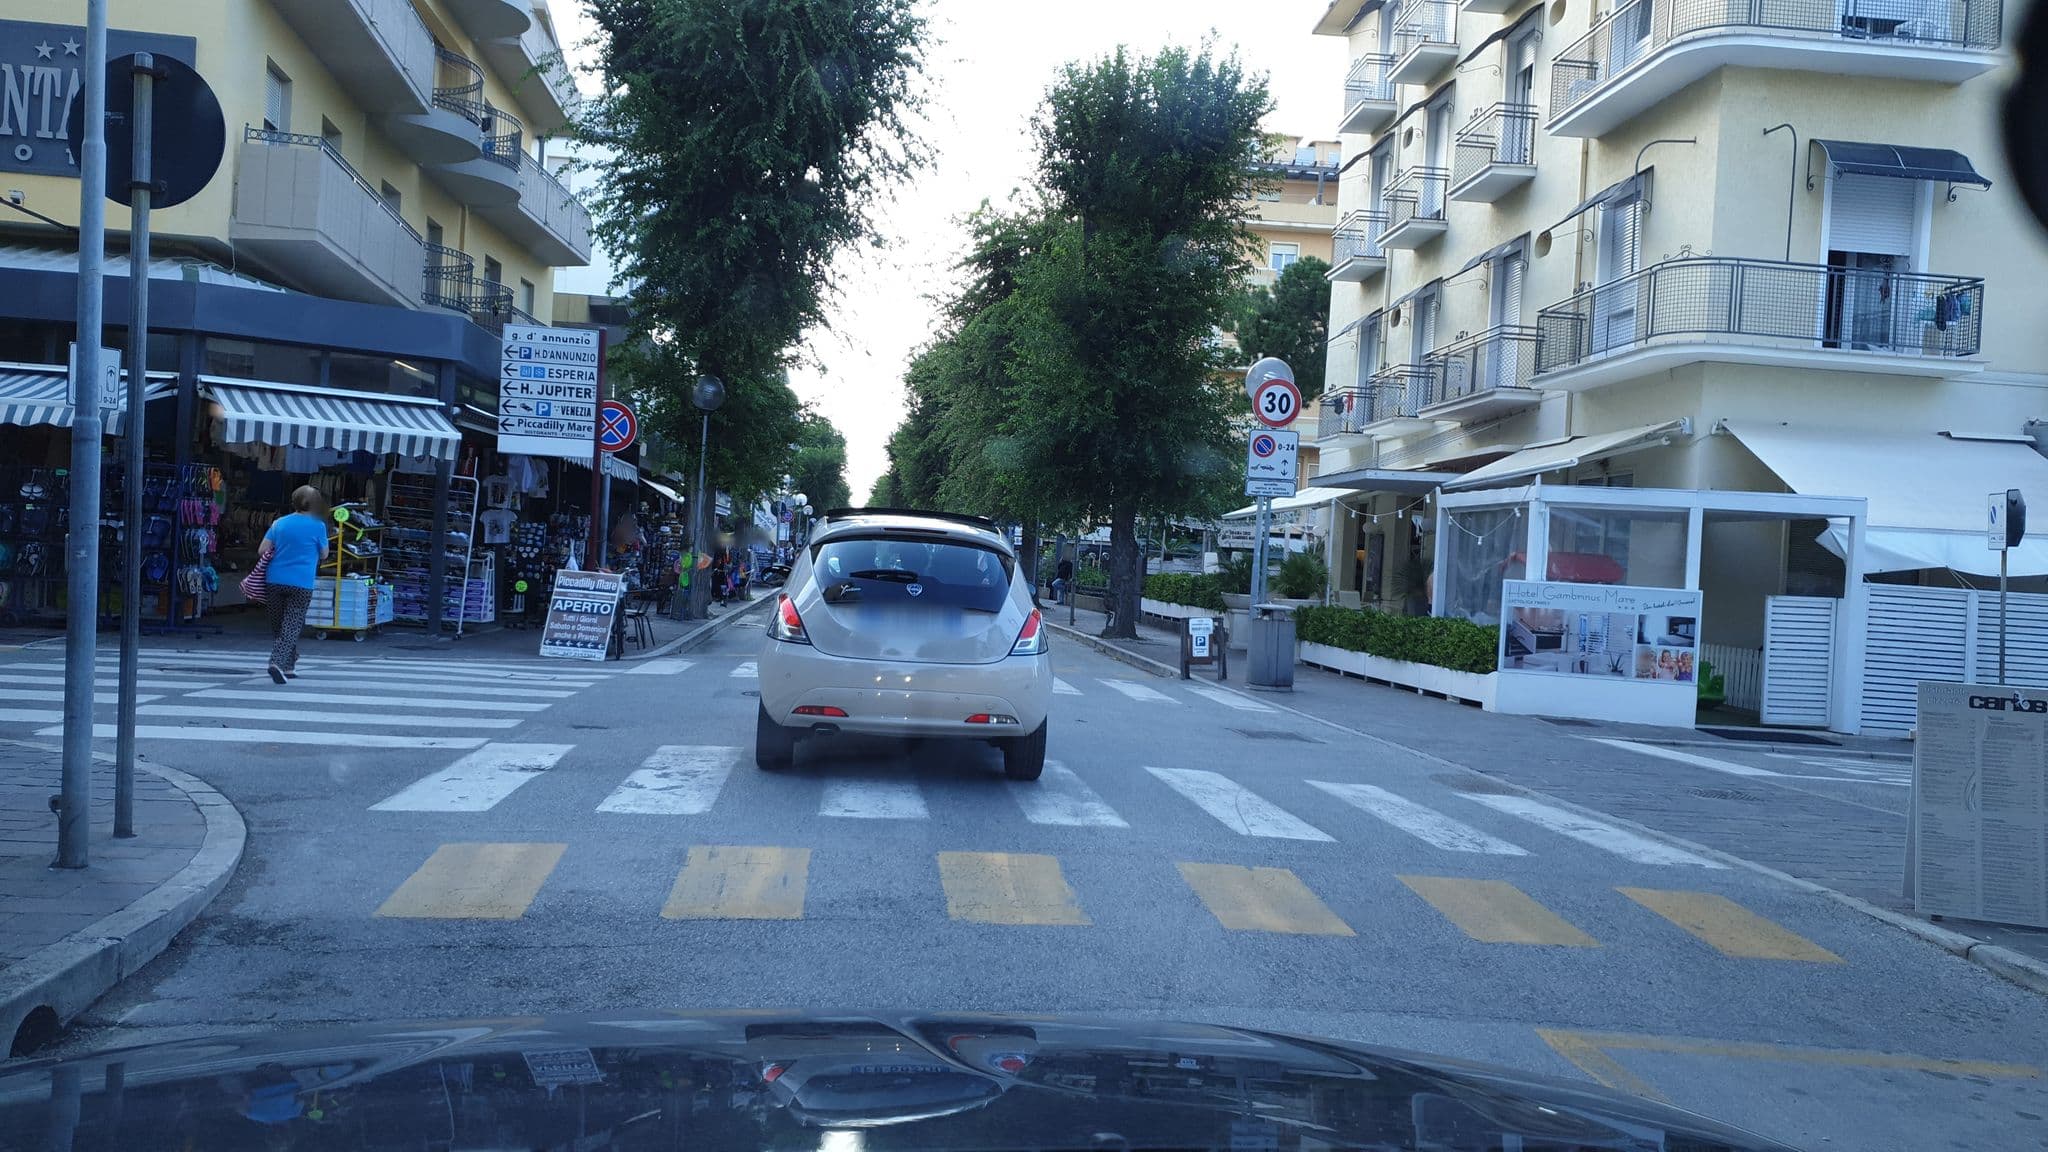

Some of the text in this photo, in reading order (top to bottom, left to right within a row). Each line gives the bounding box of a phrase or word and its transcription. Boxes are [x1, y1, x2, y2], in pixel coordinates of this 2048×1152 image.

[542, 334, 591, 345] annunzio
[548, 368, 595, 381] ESPERIA
[520, 383, 592, 399] H. JUPITER
[1264, 391, 1291, 414] 30
[561, 405, 592, 417] VENEZIA
[518, 419, 593, 433] Piccadilly Mare
[1278, 443, 1295, 451] 0-24
[558, 576, 617, 590] Piccadilly Mare
[1508, 584, 1539, 599] Hotel
[1543, 585, 1602, 602] Gambrinus
[1605, 589, 1636, 604] Mare
[553, 600, 611, 614] APERTO
[550, 622, 571, 630] Sabato
